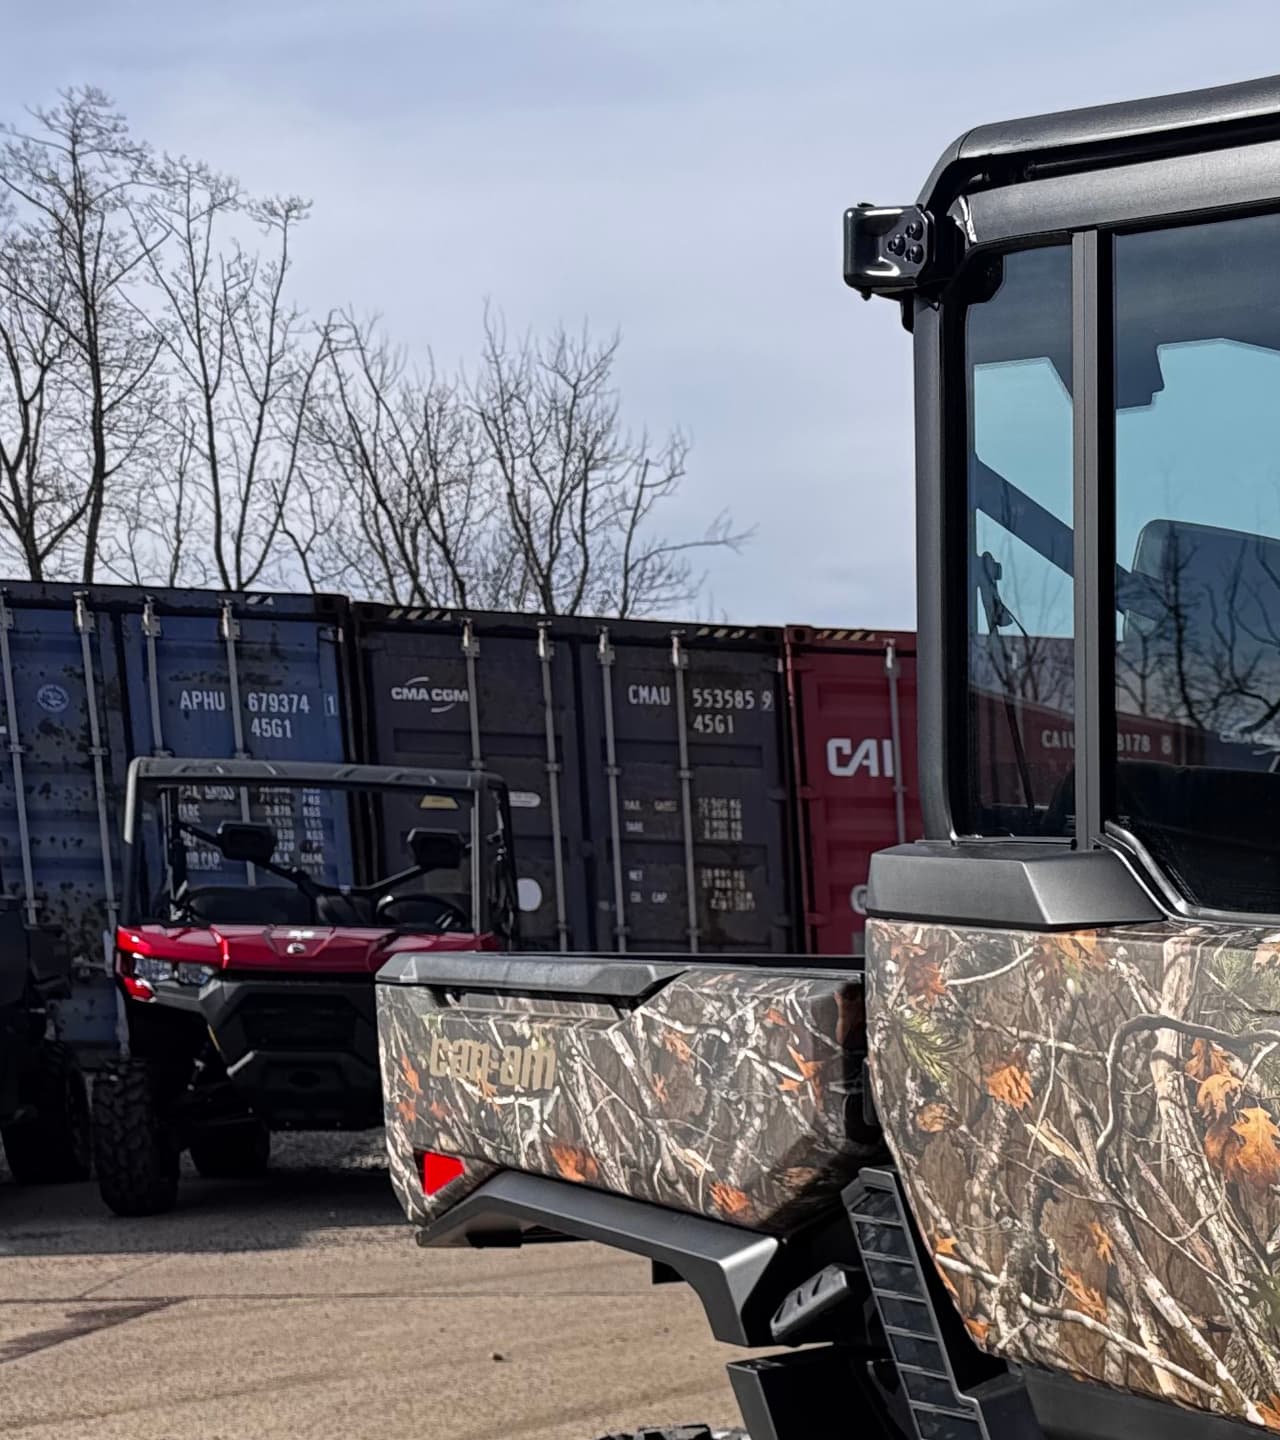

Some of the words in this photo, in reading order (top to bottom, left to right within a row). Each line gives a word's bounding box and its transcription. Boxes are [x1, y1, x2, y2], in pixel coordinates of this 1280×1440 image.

[180, 690, 225, 711] APHU
[247, 693, 310, 714] 679374
[327, 695, 336, 715] 1
[391, 687, 429, 700] CMA
[432, 689, 470, 702] CGM
[628, 685, 671, 705] CMAU
[692, 688, 754, 709] 553585
[761, 691, 773, 710] 9
[251, 718, 292, 738] 45G1
[693, 714, 734, 733] 45G1
